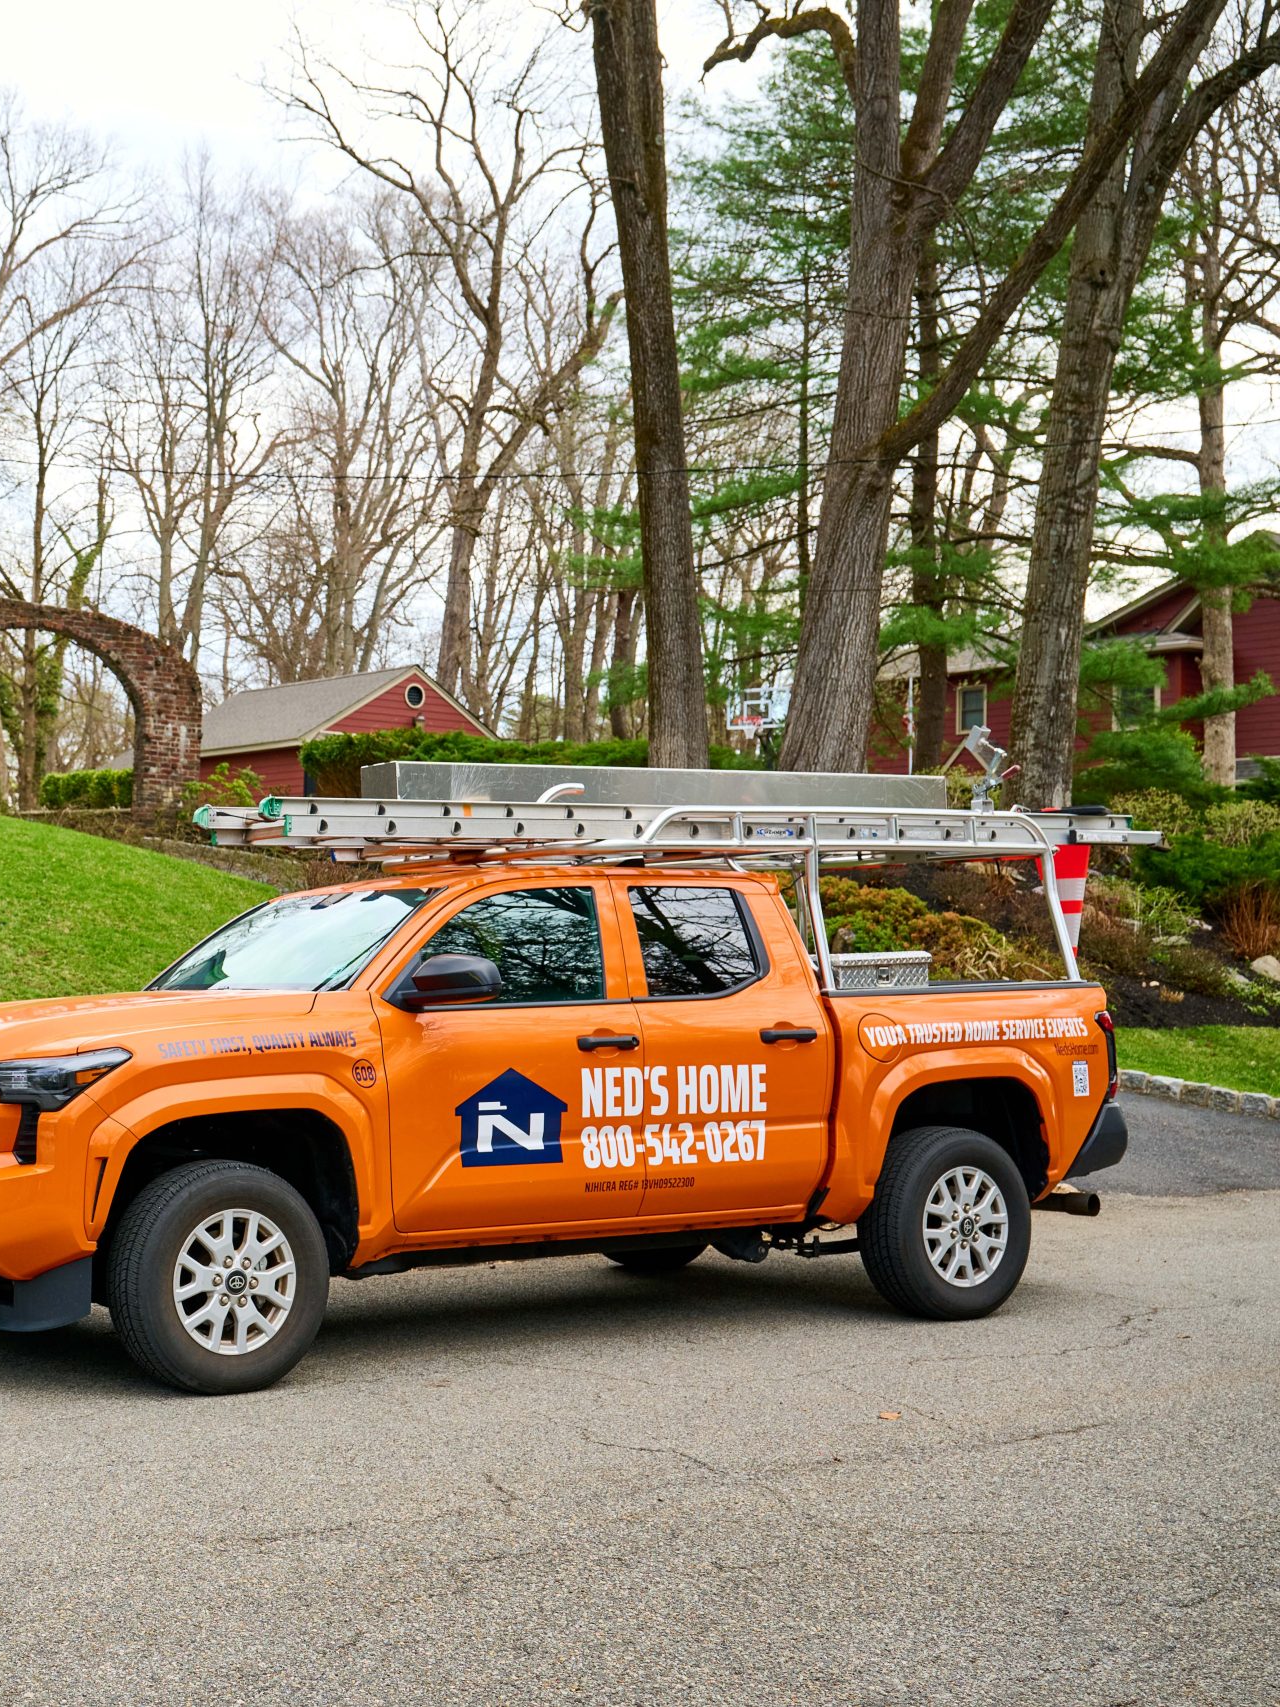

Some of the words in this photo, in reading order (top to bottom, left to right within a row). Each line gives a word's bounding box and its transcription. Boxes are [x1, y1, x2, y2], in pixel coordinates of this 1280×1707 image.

[158, 1039, 207, 1060] SAFETY
[211, 1036, 252, 1055] FIRST,
[254, 1032, 306, 1053] QUALITY
[310, 1030, 357, 1048] ALWAYS
[863, 1024, 908, 1048] YOUR
[907, 1021, 963, 1044] TRUSTED
[964, 1020, 1000, 1042] HOME
[1002, 1018, 1046, 1040] SERVICE
[1047, 1017, 1089, 1038] EXPERTS
[354, 1065, 375, 1082] 608
[581, 1065, 669, 1118] NED'S
[677, 1064, 768, 1115] HOME
[580, 1119, 766, 1169] 800-542-0267
[584, 1180, 617, 1193] NJHICRA
[619, 1179, 639, 1191] REG#
[641, 1176, 695, 1190] 13VH09522300
